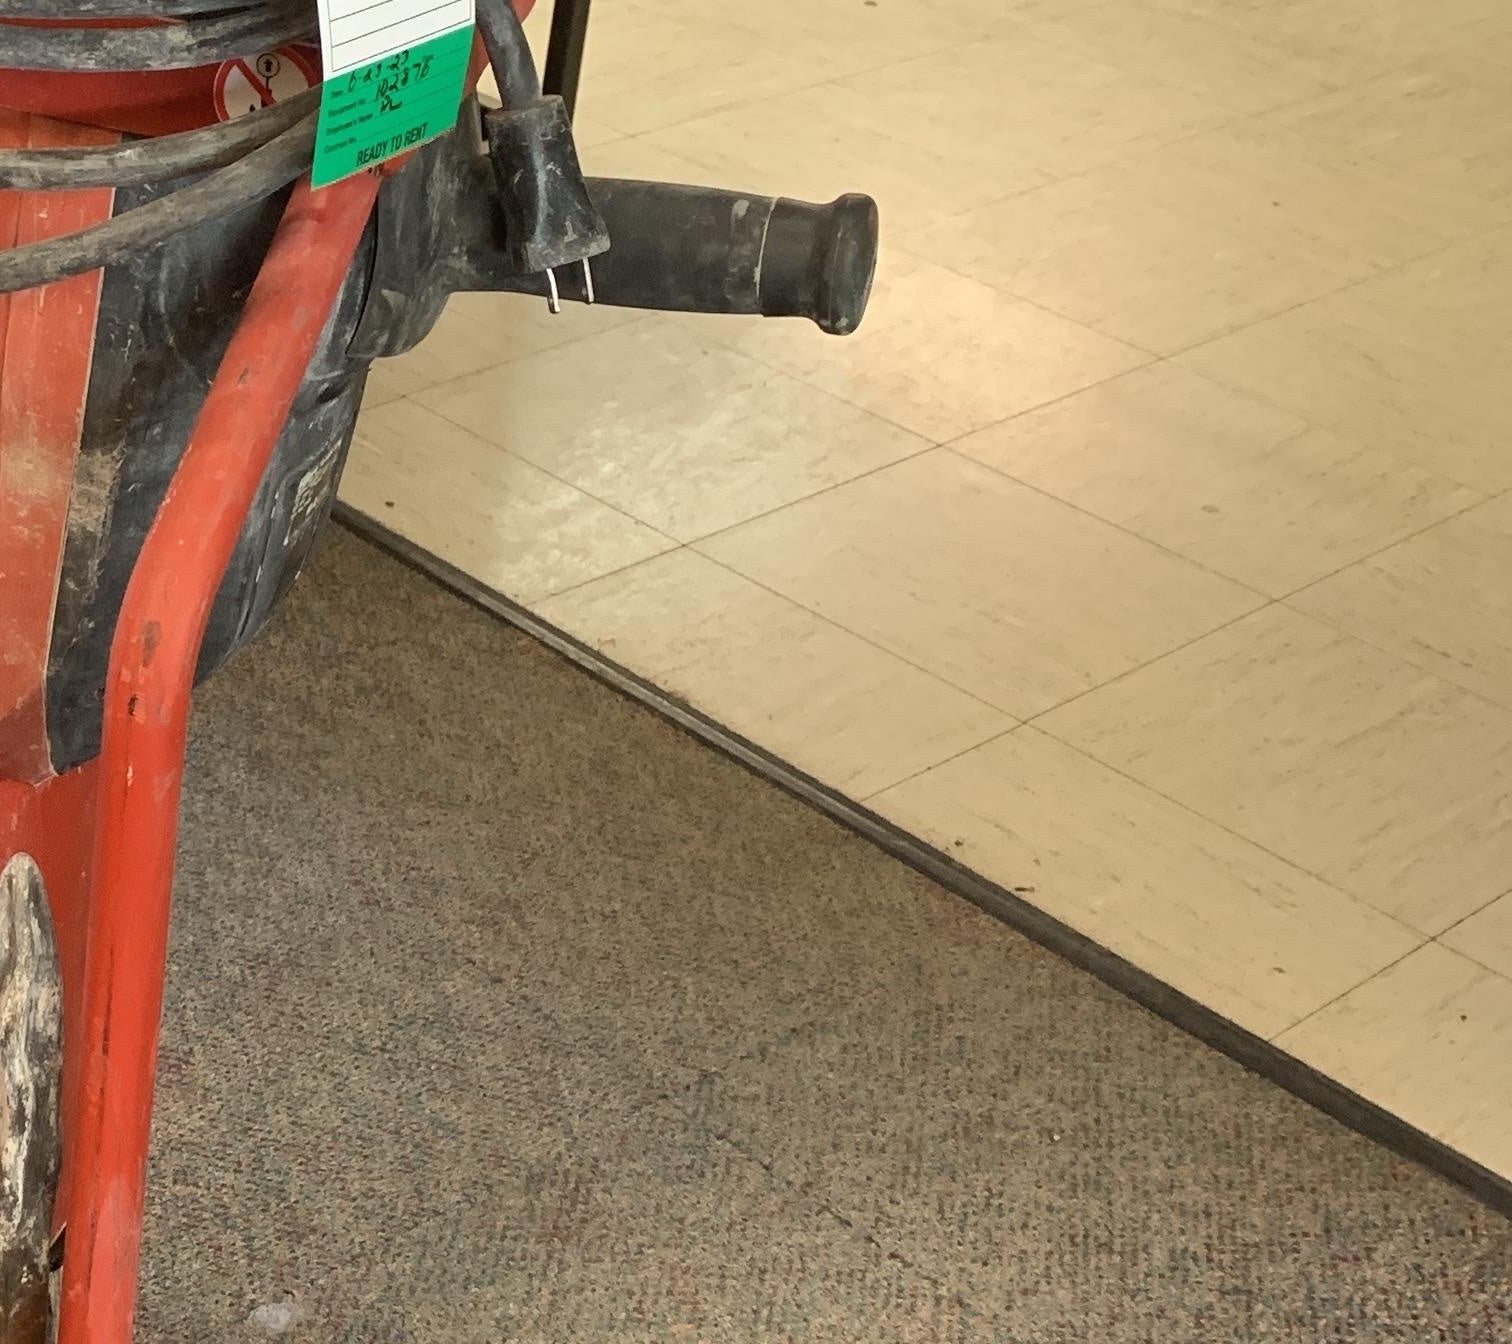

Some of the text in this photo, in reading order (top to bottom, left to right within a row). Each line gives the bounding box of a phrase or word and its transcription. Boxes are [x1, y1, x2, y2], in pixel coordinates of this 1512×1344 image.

[356, 139, 389, 167] READY
[390, 134, 402, 153] TO
[404, 122, 429, 147] RENT
